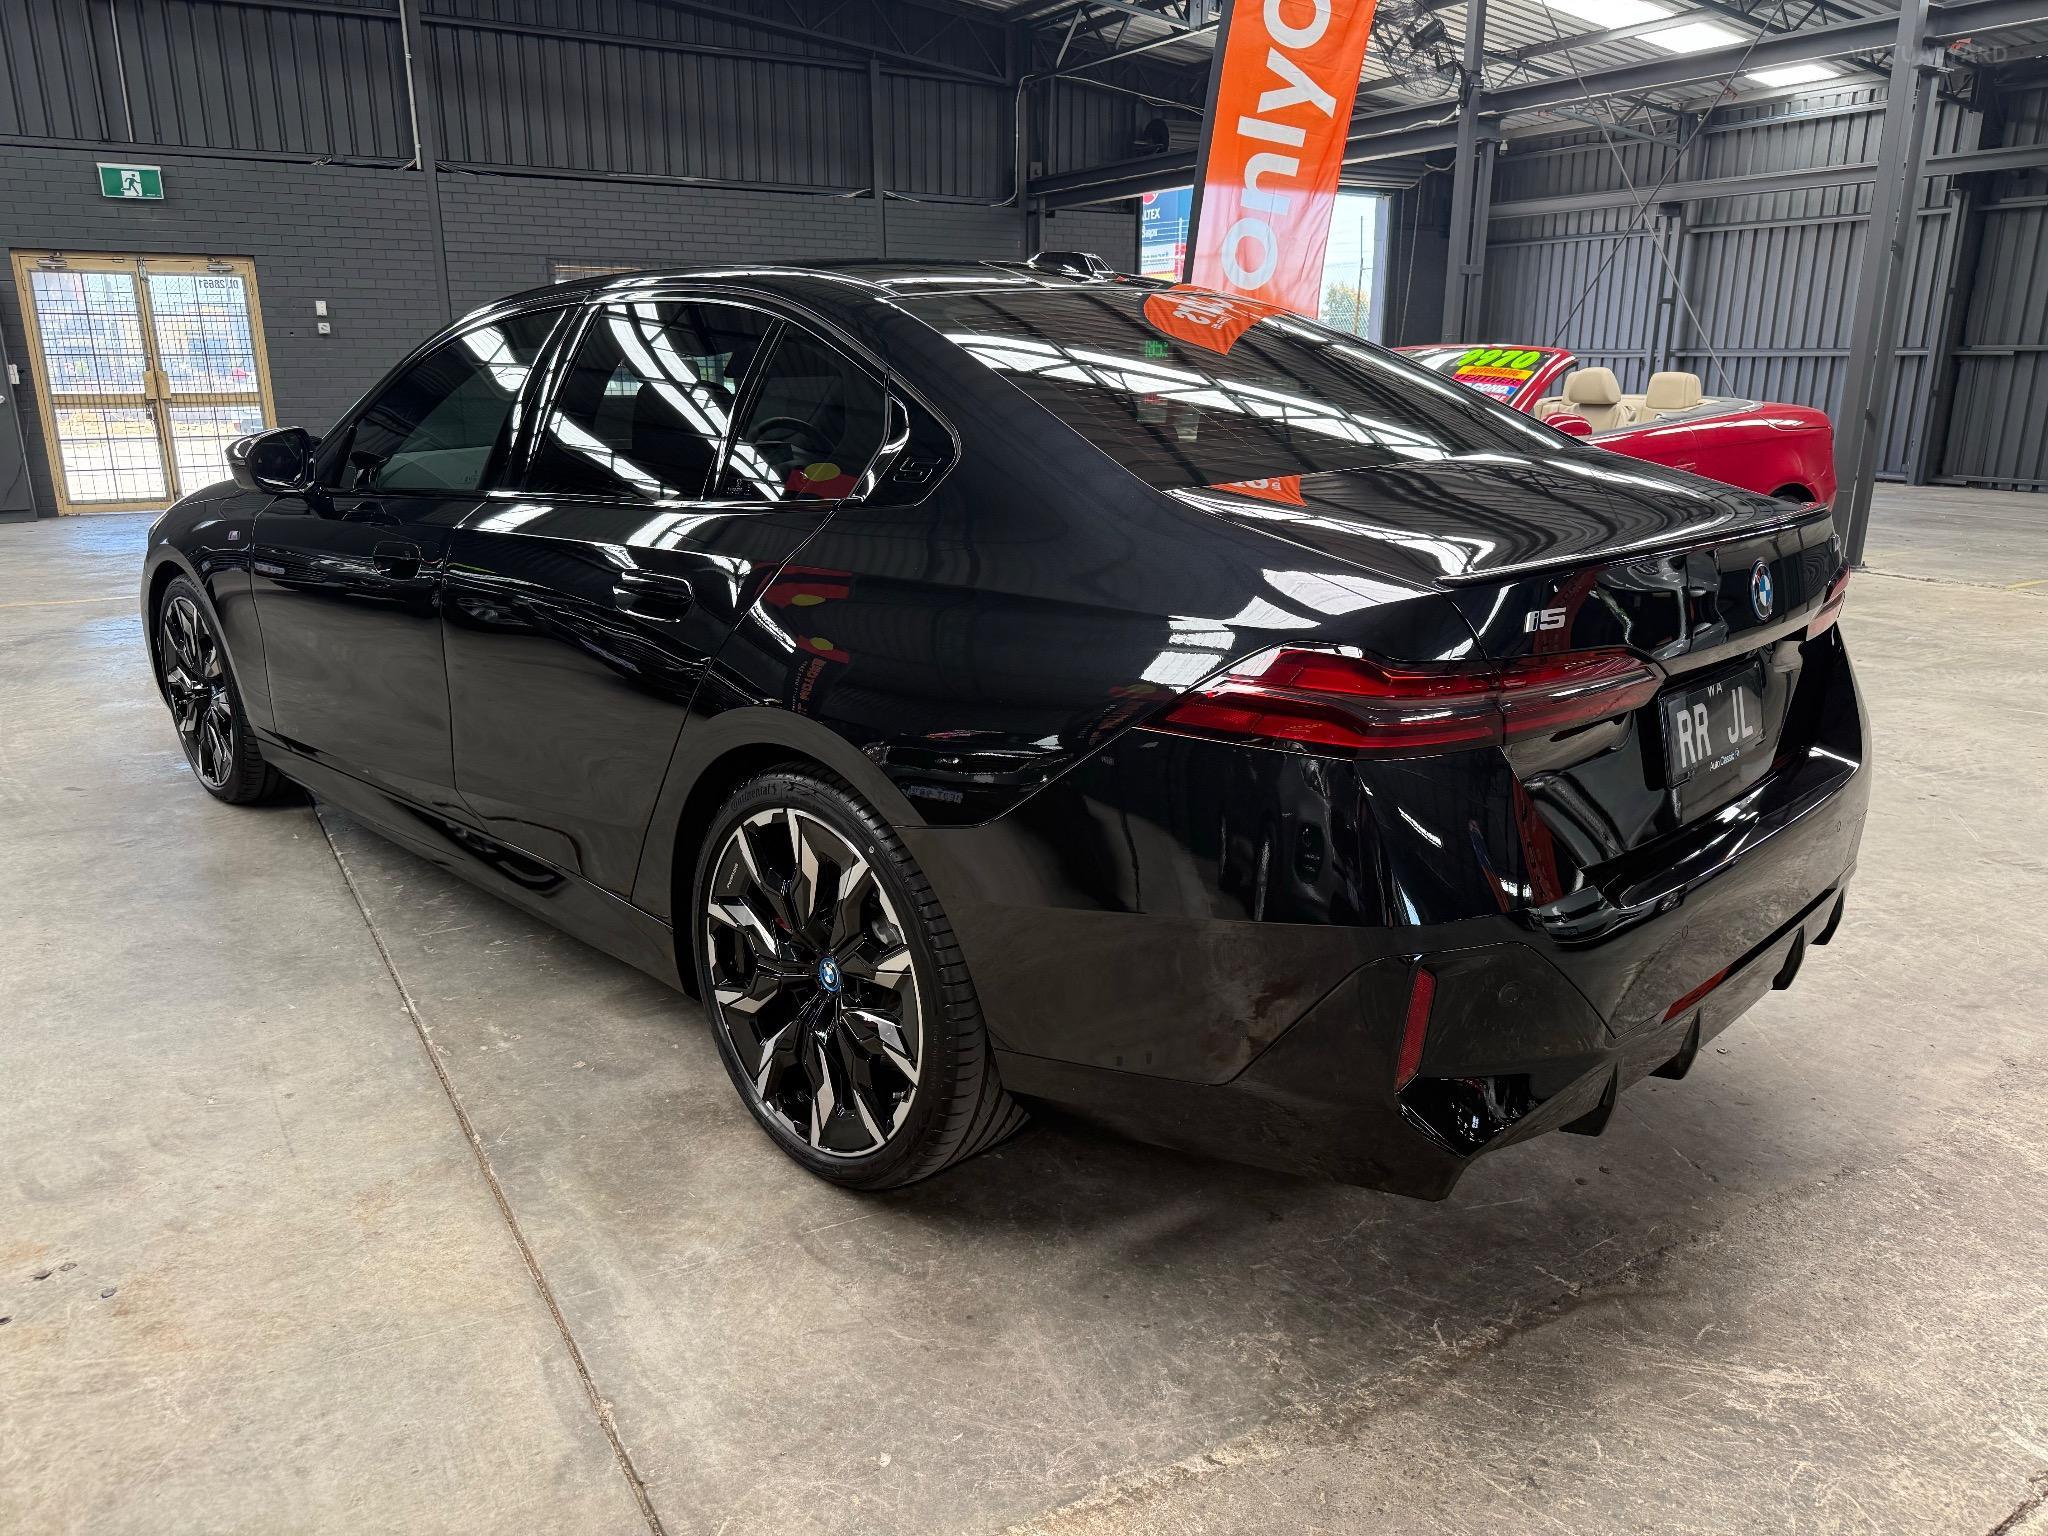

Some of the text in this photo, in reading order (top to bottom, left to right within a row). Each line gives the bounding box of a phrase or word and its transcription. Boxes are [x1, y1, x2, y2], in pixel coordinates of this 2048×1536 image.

[1523, 606, 1567, 633] i5
[1707, 682, 1723, 698] WA
[1676, 686, 1754, 769] RR JL
